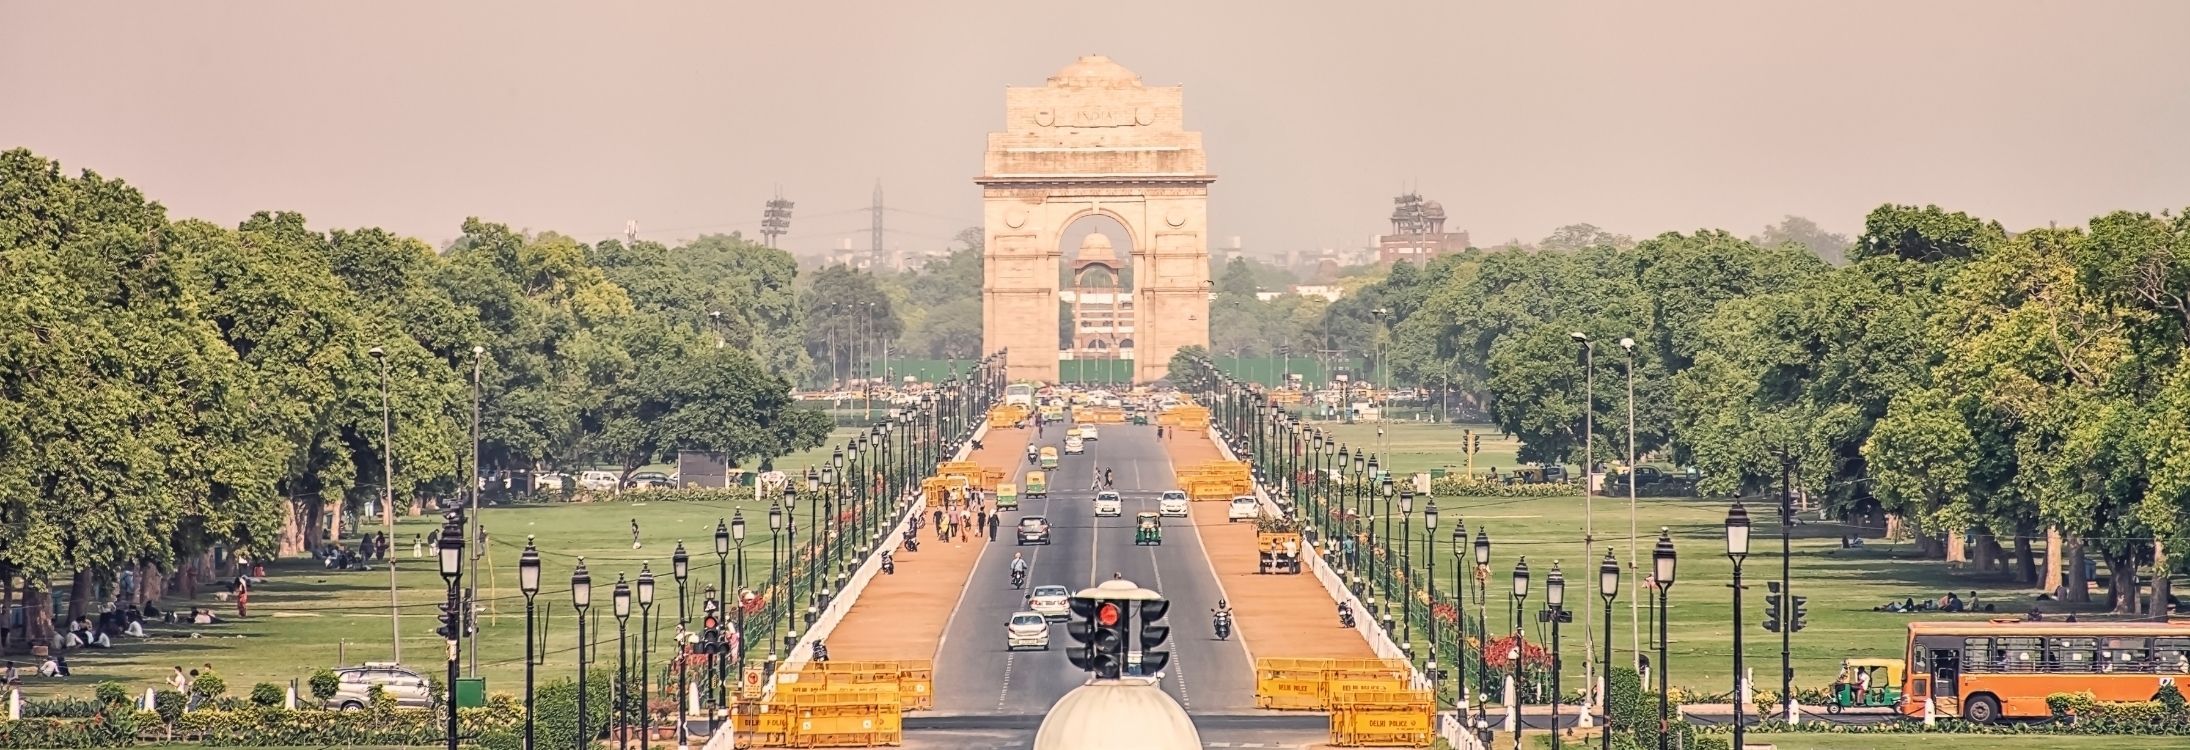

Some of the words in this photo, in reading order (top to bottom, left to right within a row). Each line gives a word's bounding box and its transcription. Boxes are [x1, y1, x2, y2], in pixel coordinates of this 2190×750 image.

[1075, 111, 1113, 121] INDIA
[1369, 720, 1386, 728] DELHI
[1389, 720, 1408, 728] POLICE
